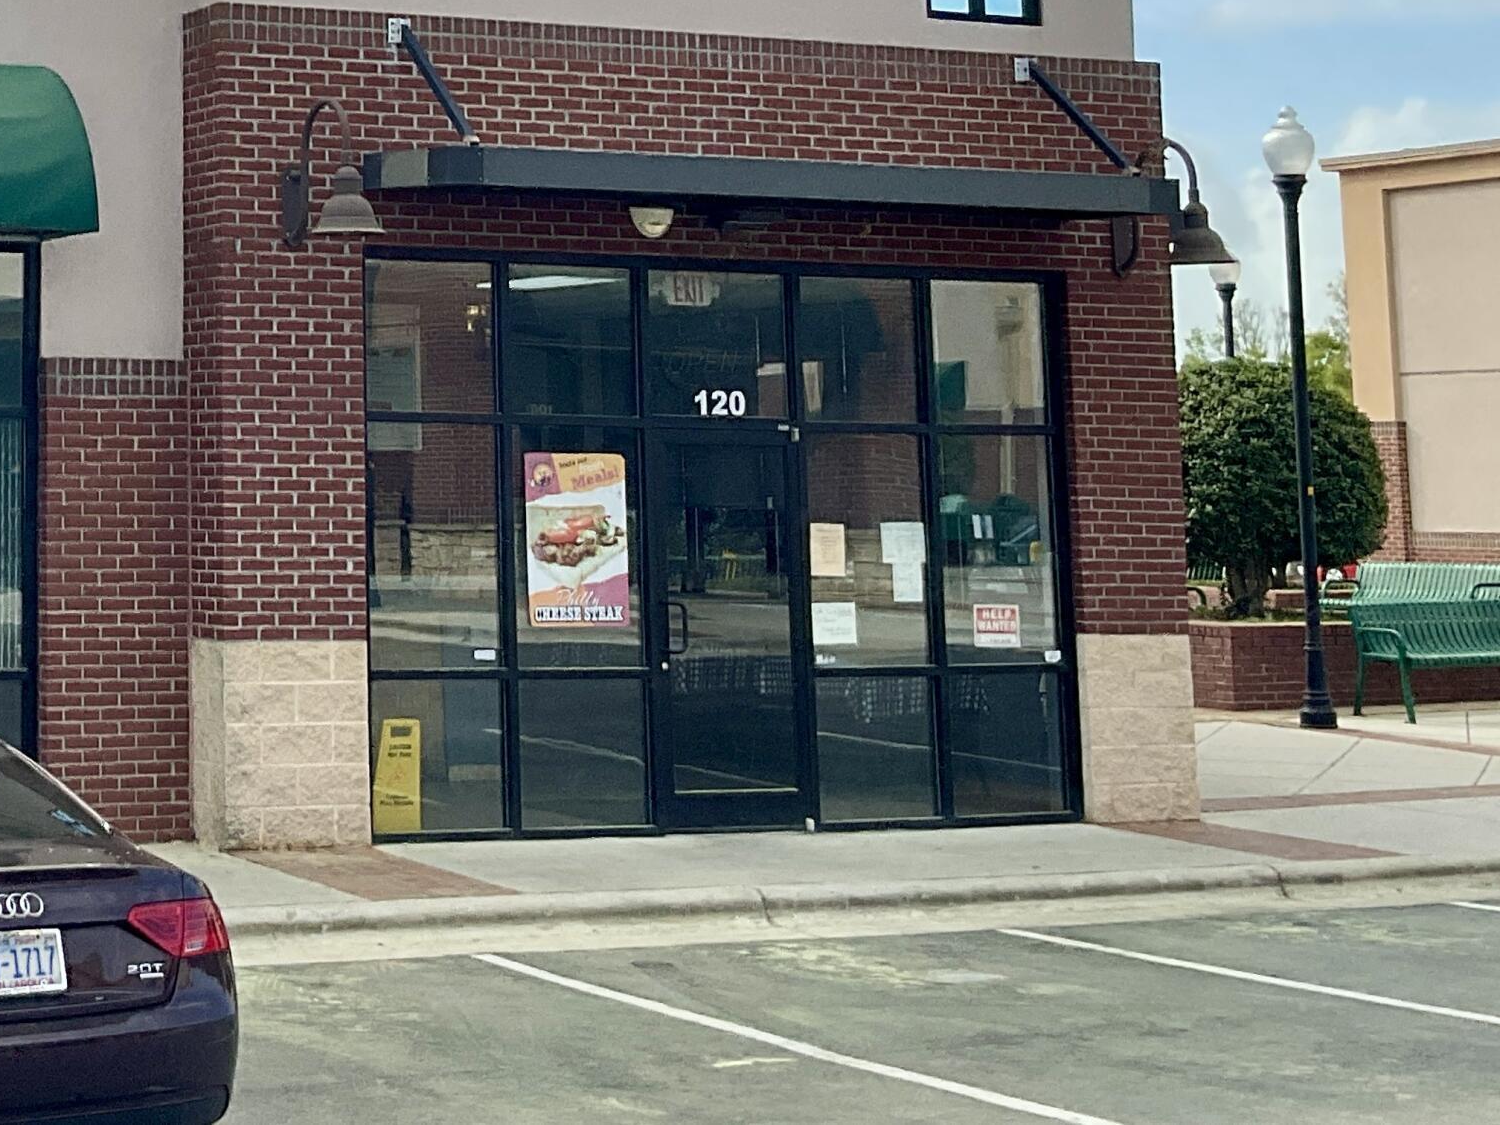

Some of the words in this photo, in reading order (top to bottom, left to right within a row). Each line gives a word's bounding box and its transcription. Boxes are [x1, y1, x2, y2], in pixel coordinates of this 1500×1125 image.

[694, 389, 746, 417] 120
[535, 606, 582, 622] CHEESE
[584, 605, 624, 621] STEAK
[981, 607, 1013, 620] HELP
[977, 620, 1017, 633] WANTED
